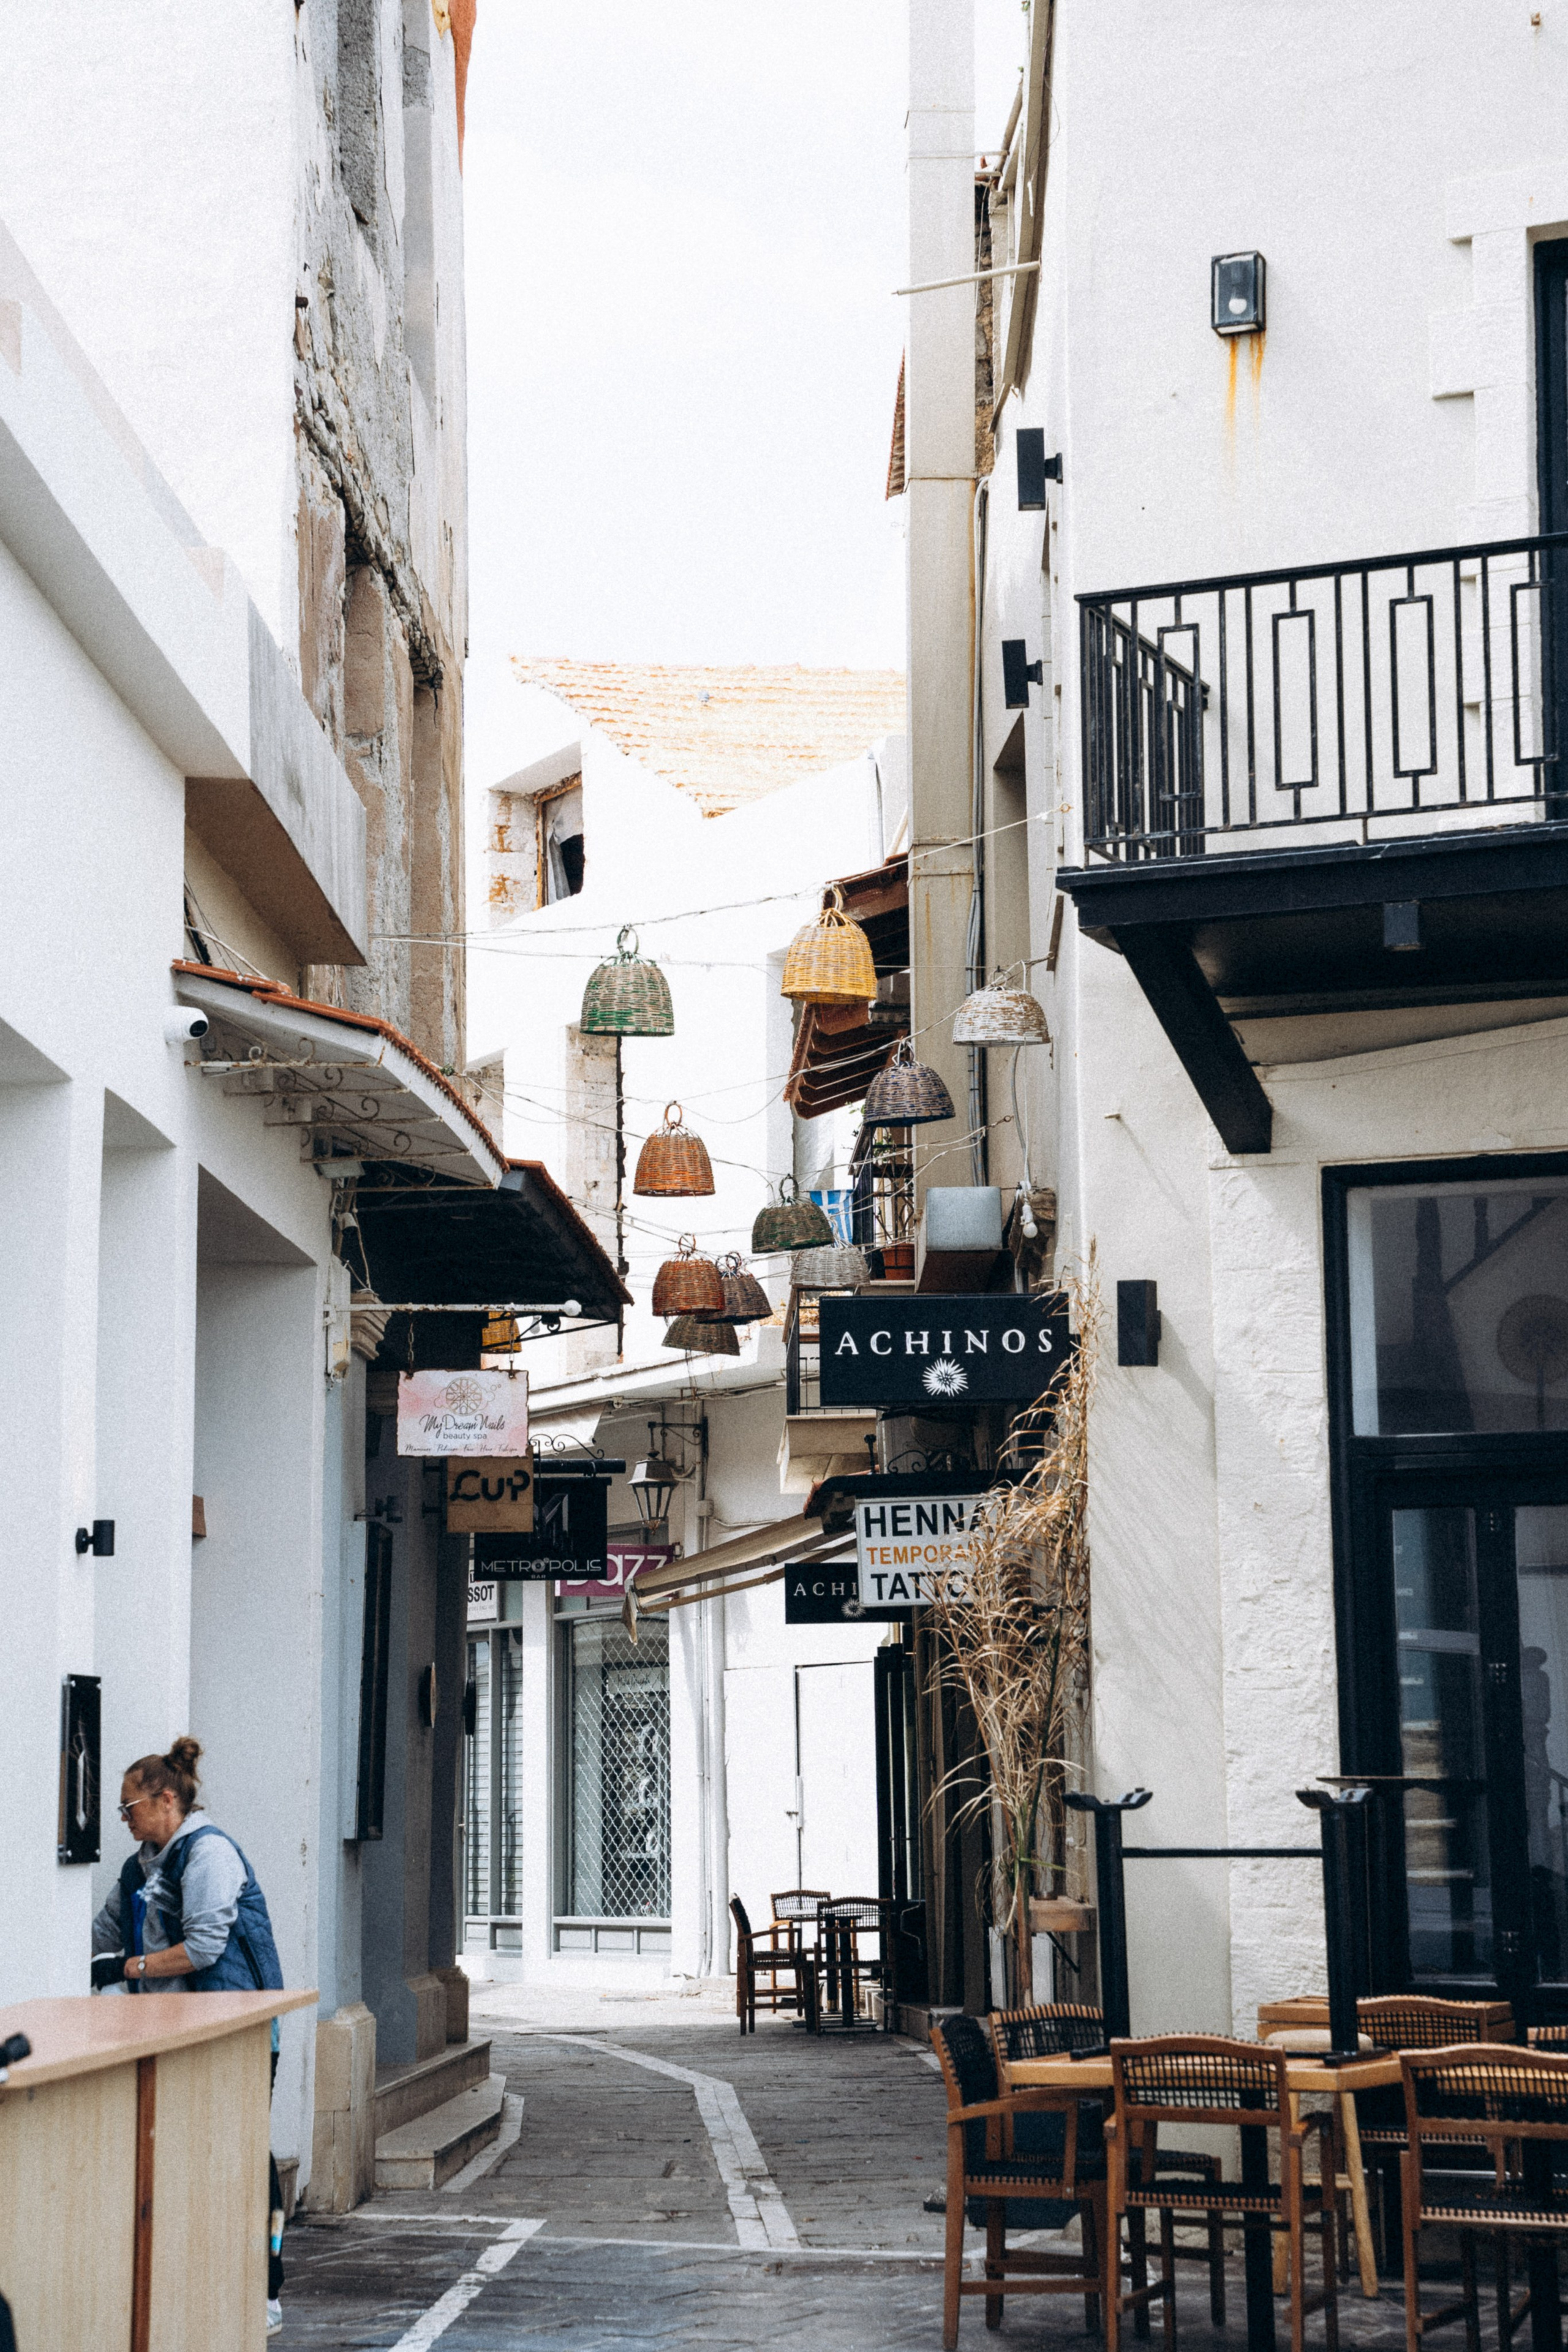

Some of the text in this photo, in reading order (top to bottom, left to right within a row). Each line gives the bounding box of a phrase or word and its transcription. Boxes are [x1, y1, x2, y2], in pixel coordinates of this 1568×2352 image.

[834, 1329, 1052, 1355] ACHINOS
[419, 1414, 505, 1438] My Dream Nails
[864, 1502, 994, 1538] HENNA
[481, 1557, 602, 1573] METROPOLIS
[866, 1544, 981, 1565] TEMPORAR
[467, 1584, 494, 1603] SSOT
[793, 1582, 857, 1596] ACHI
